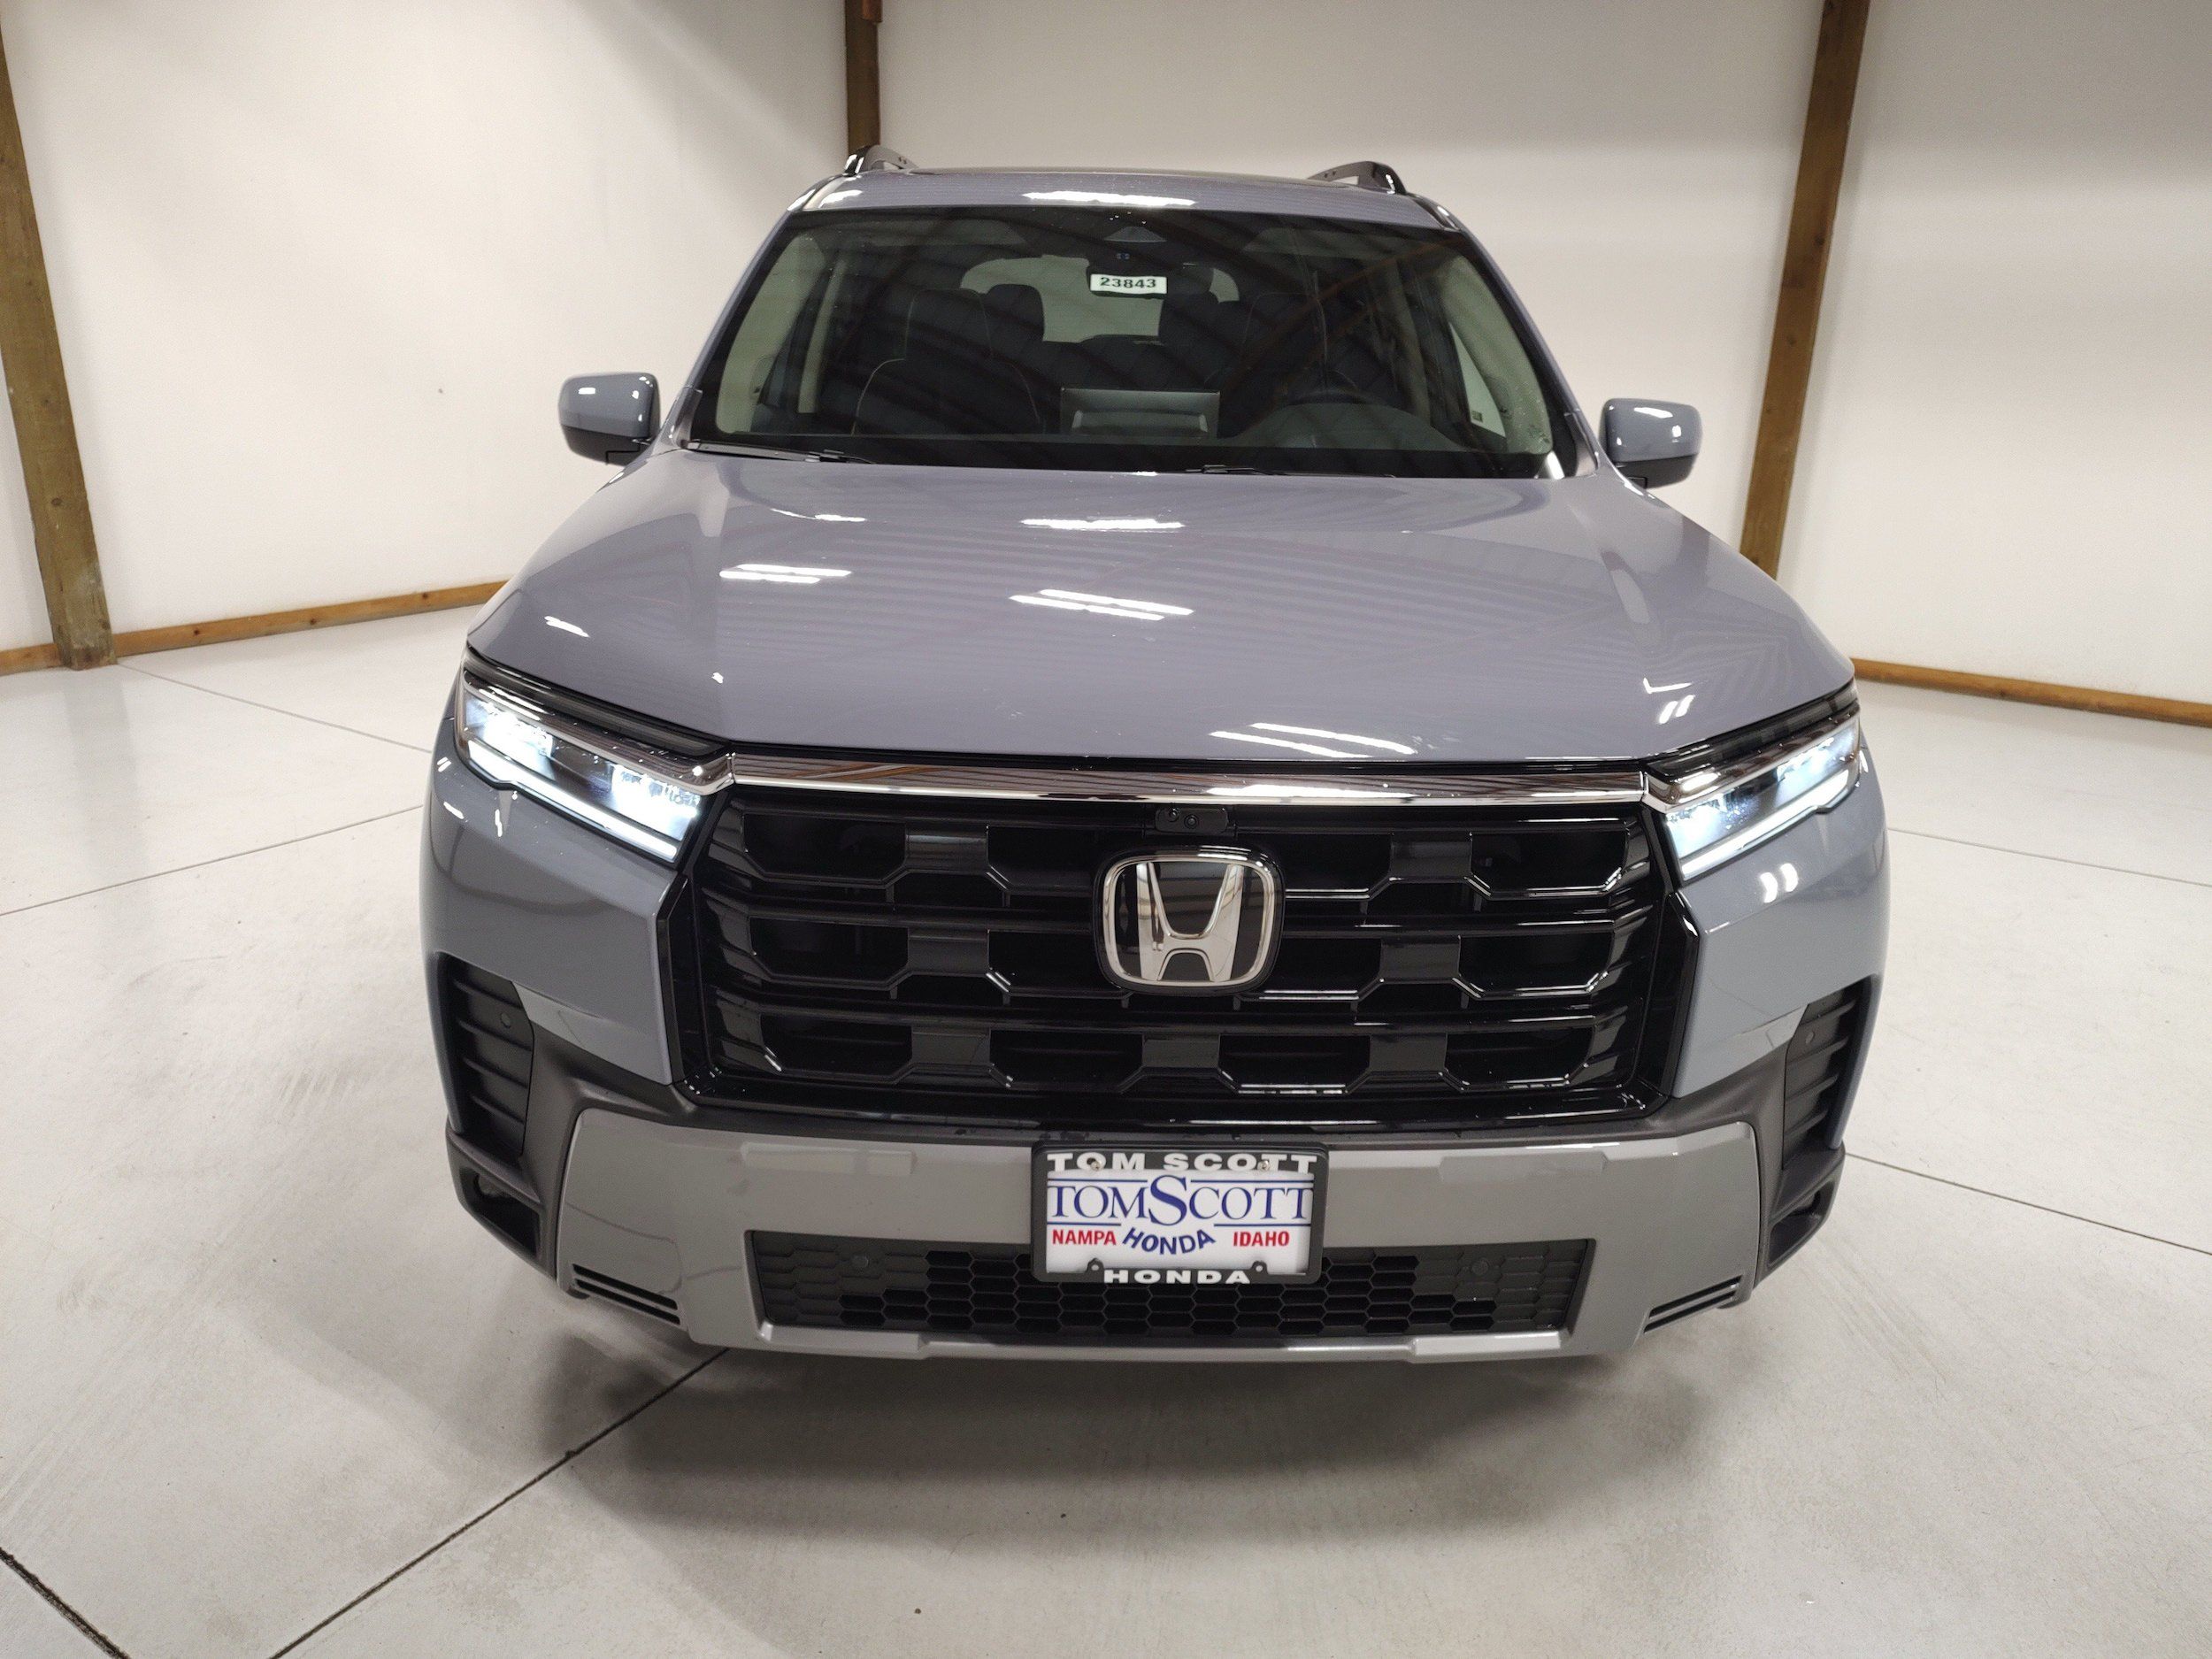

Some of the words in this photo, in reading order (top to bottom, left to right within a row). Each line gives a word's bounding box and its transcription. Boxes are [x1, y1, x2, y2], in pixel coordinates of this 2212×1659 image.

[1100, 277, 1156, 288] 23843
[1047, 1153, 1146, 1172] TOM
[1163, 1153, 1317, 1174] SCOTT
[1052, 1229, 1118, 1246] NAMPA
[1122, 1227, 1217, 1255] HONDA
[1233, 1231, 1291, 1247] IDAHO
[1103, 1270, 1251, 1285] HONDA
